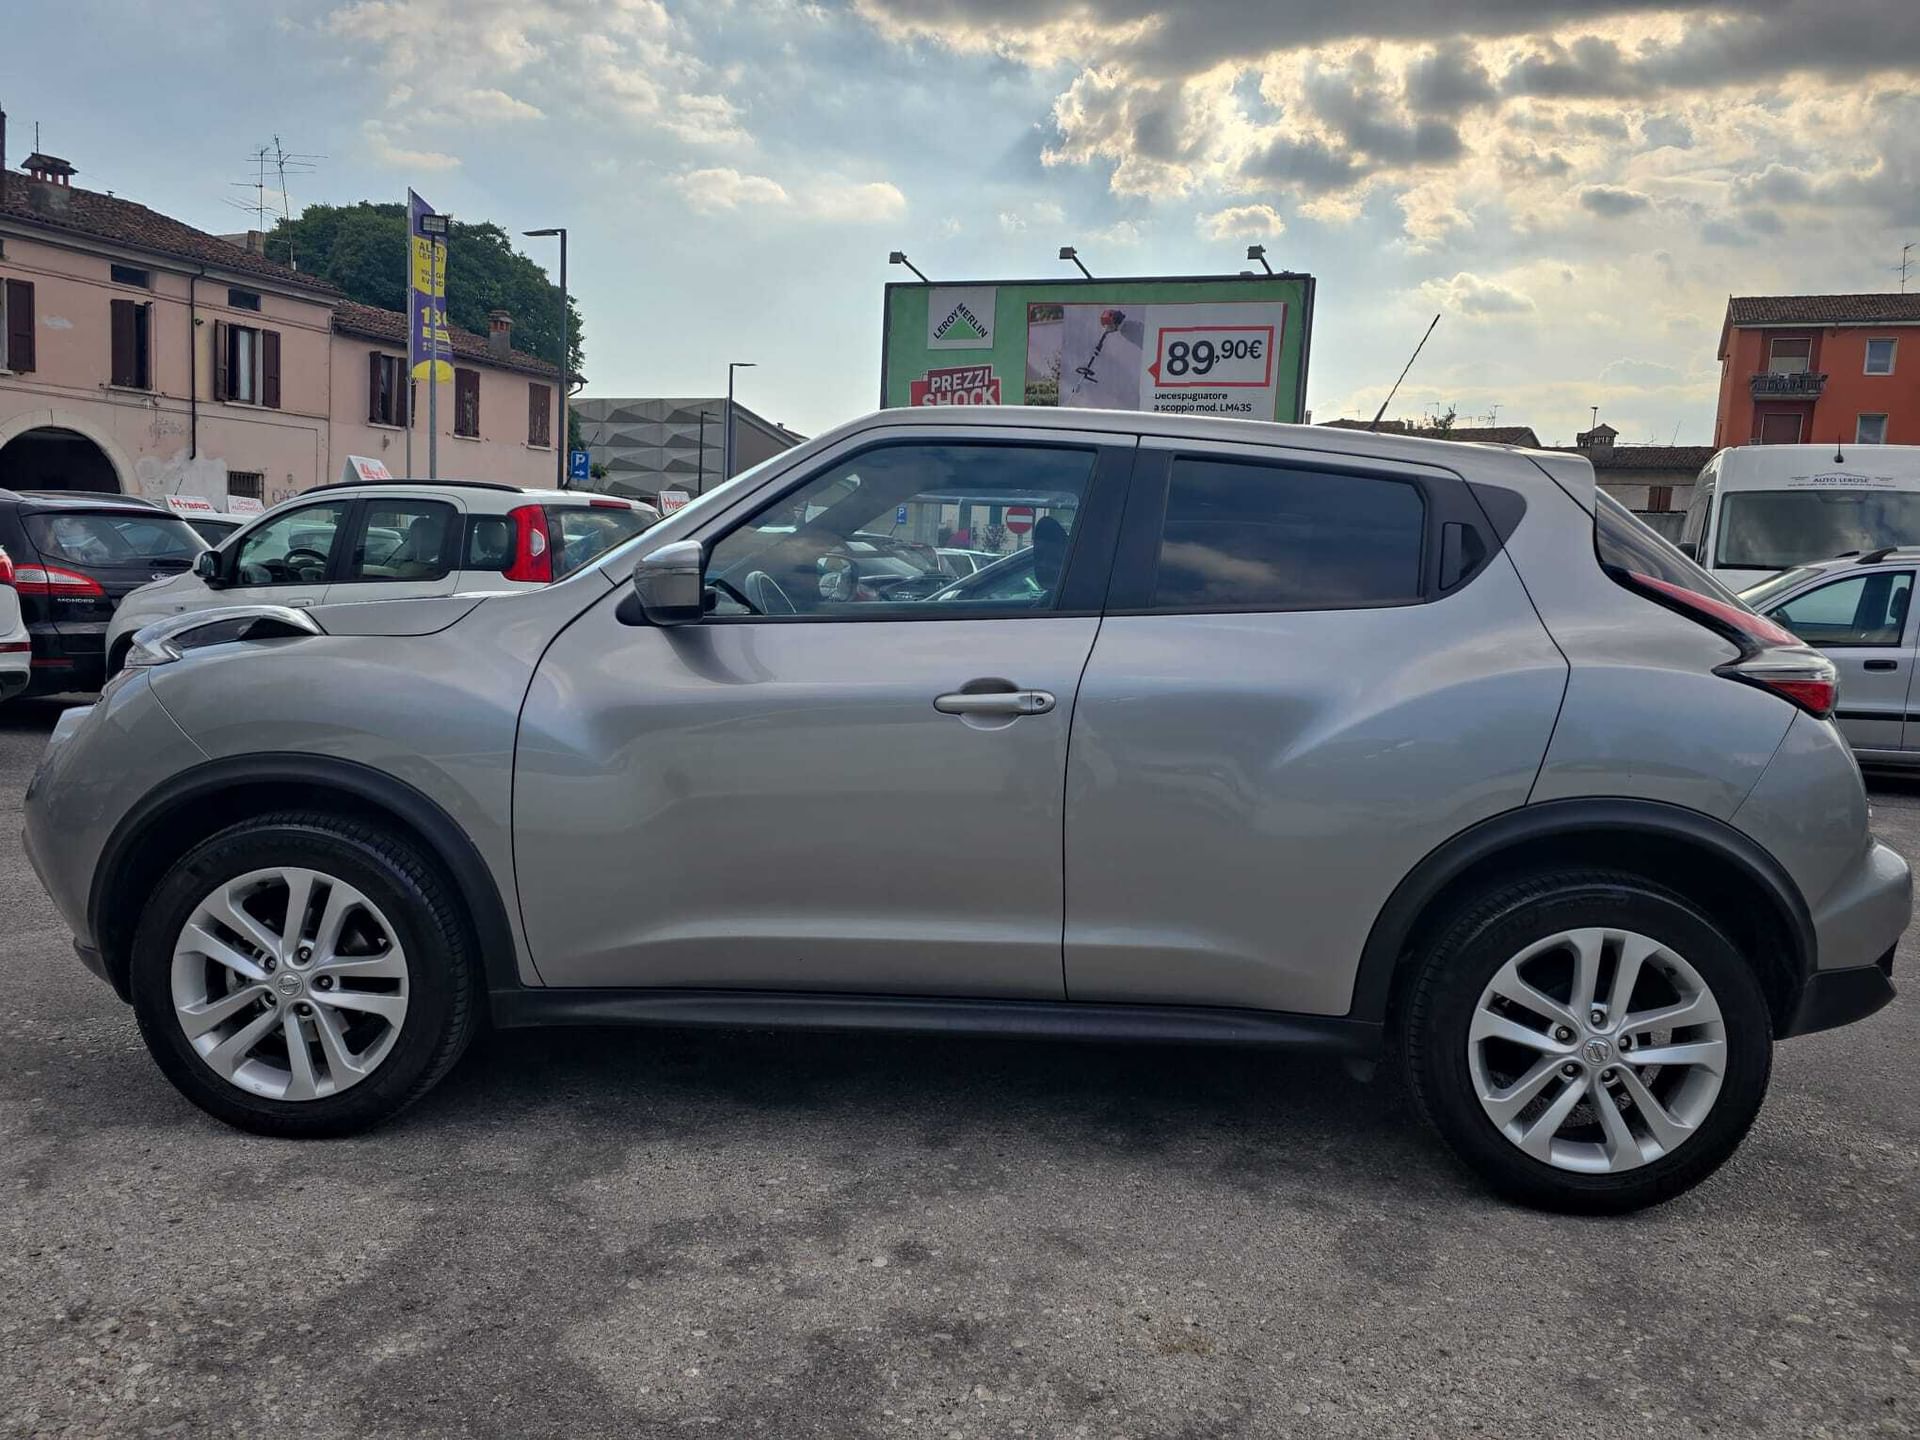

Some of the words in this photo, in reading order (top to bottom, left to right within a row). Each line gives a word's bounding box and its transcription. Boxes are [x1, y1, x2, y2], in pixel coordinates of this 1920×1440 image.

[933, 309, 960, 340] LEROY
[956, 302, 988, 338] MERLIN
[930, 369, 990, 393] PREZZI
[922, 385, 997, 406] SHOCK
[1160, 403, 1195, 414] scoppio
[1196, 403, 1218, 412] mod.
[575, 453, 586, 467] P
